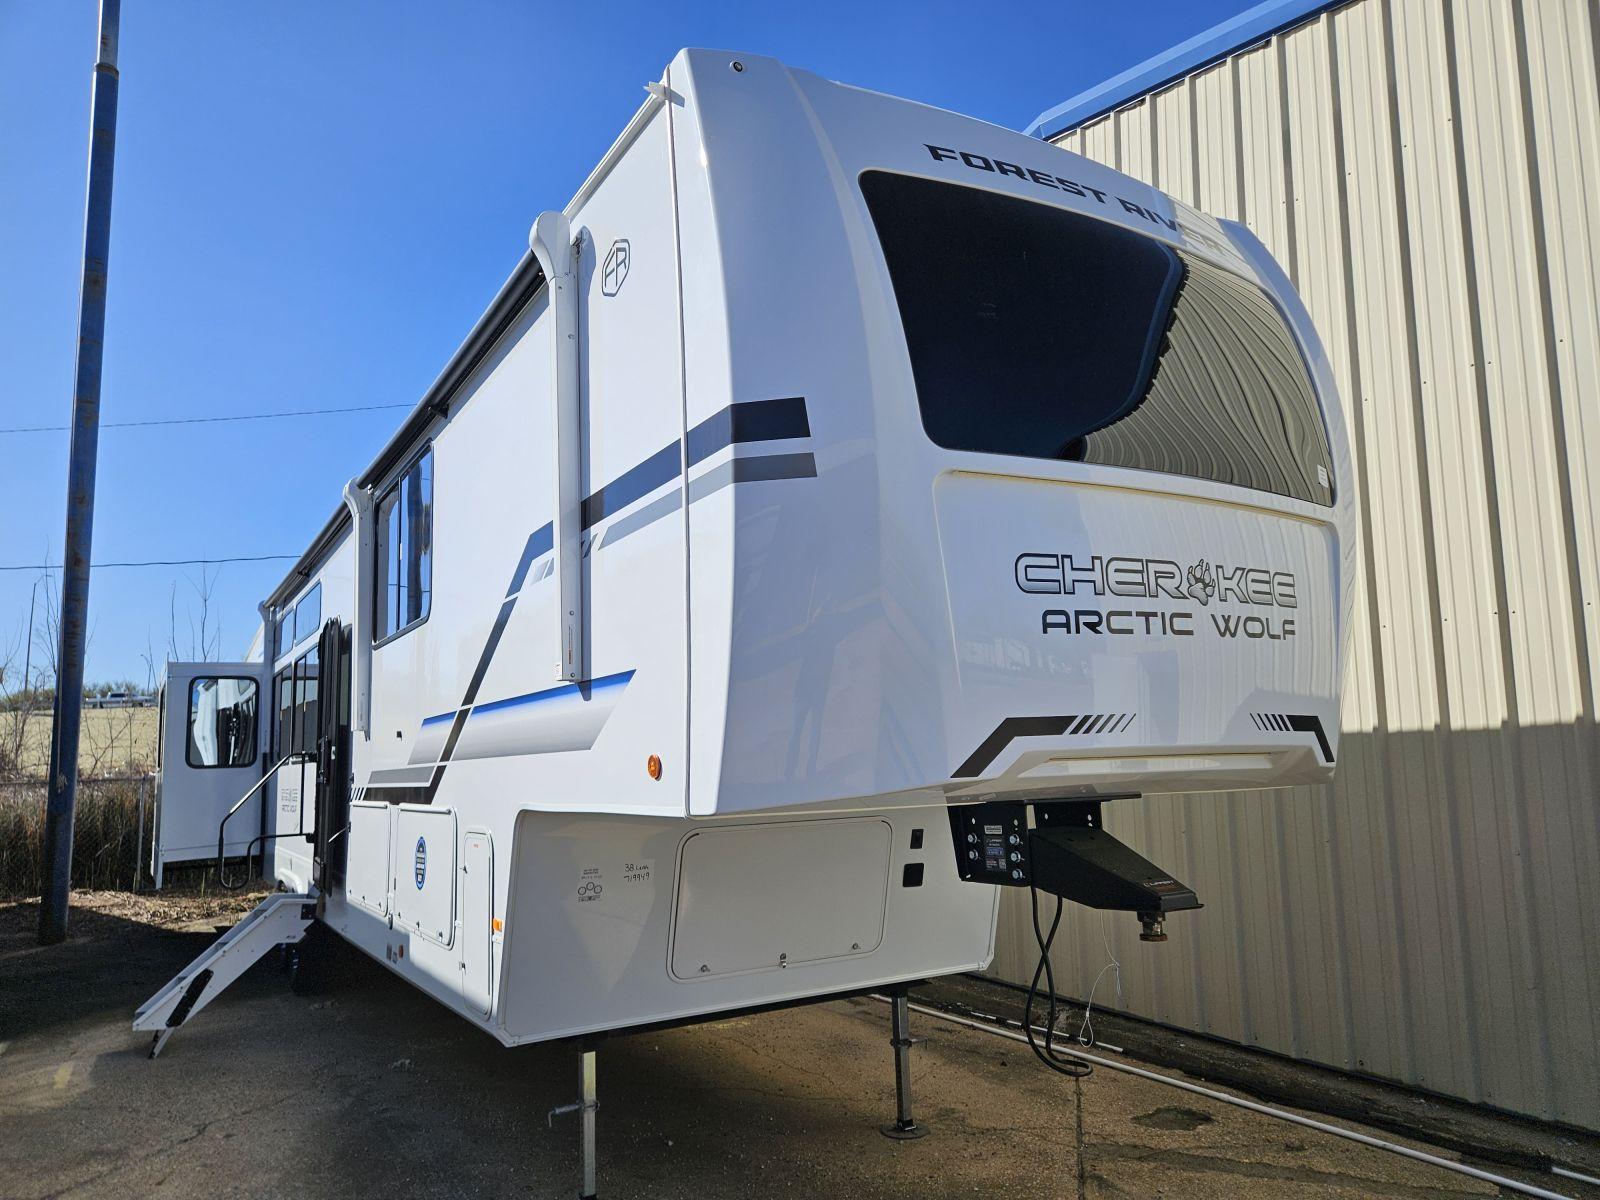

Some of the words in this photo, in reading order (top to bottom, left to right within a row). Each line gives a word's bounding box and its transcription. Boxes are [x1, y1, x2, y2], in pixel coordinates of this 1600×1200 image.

[923, 143, 1108, 204] FOREST
[1015, 553, 1297, 609] CHERKEE
[1042, 609, 1194, 635] ARCTIC
[1211, 613, 1296, 640] WOLF
